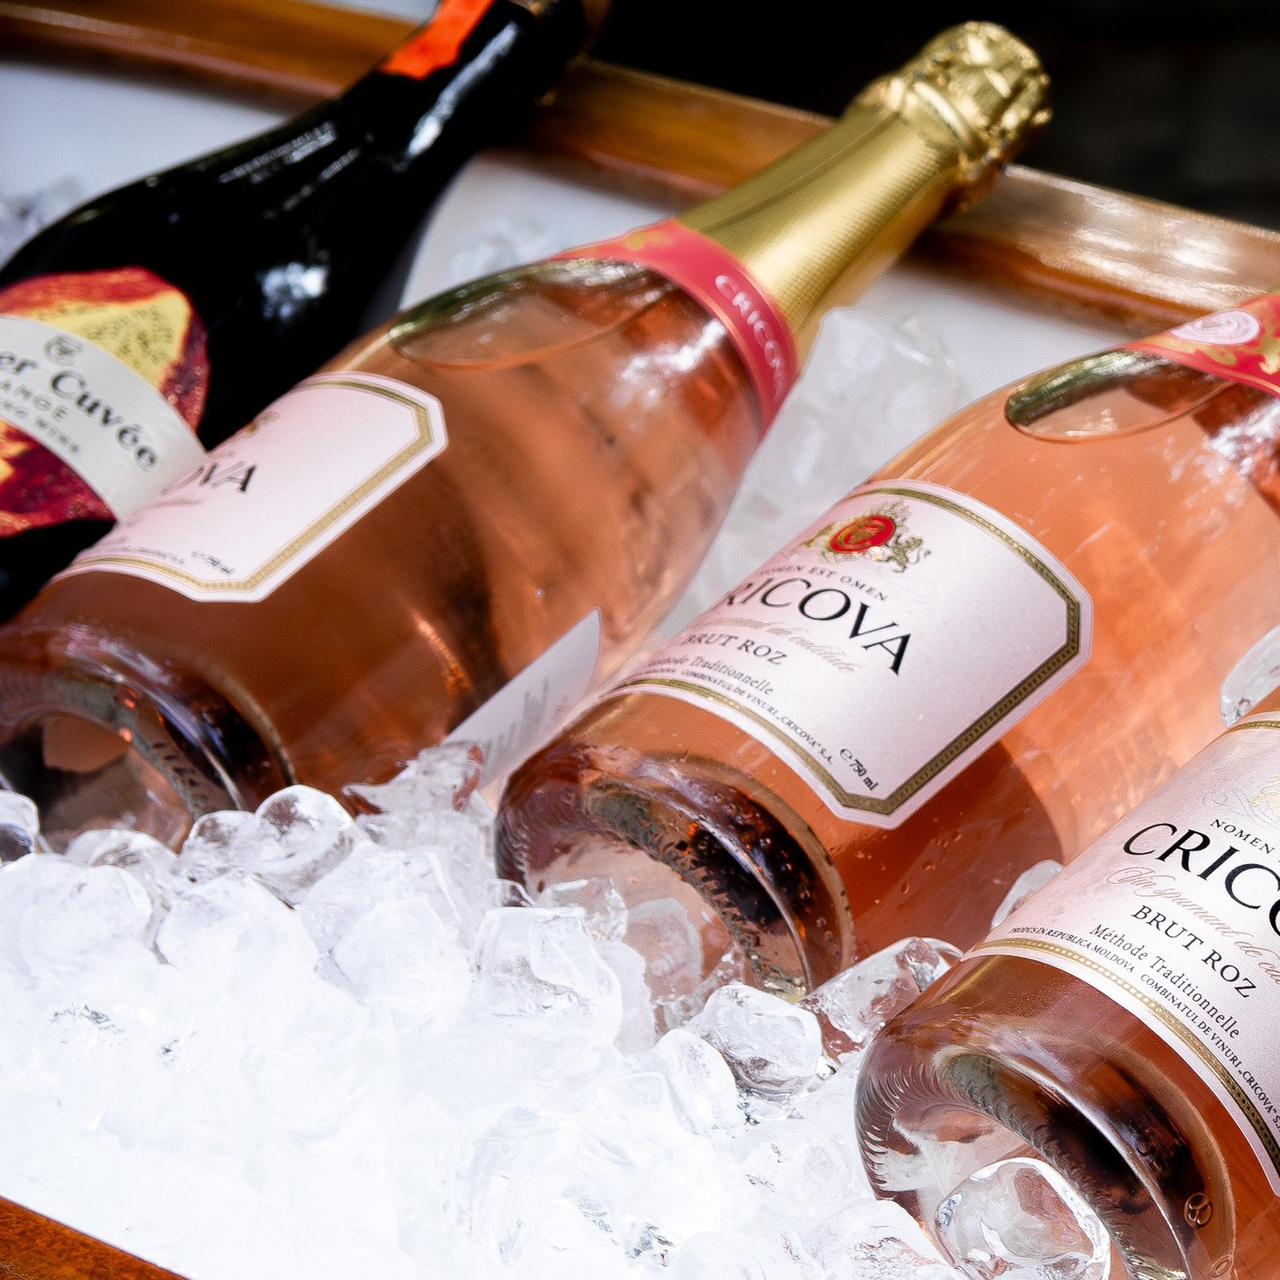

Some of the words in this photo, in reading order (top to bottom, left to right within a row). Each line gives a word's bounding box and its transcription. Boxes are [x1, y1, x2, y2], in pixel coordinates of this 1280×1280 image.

[50, 369, 157, 471] Cuvée
[840, 575, 888, 602] OMEN
[738, 639, 787, 667] ROZ
[690, 656, 774, 697] Traditionnelle
[747, 693, 779, 717] VINURI
[848, 759, 868, 779] 750
[862, 775, 880, 792] ml
[1210, 818, 1275, 855] NOMEN
[1131, 904, 1205, 952] BRUT
[1201, 948, 1258, 999] ROZ
[1045, 927, 1092, 950] REPUBLICA
[1091, 944, 1136, 974] MOLDOVA
[1140, 973, 1198, 1025] COMBINATUL
[1196, 1020, 1212, 1037] DE
[1210, 1032, 1241, 1068] VINURI
[1089, 923, 1149, 962] Méthode
[1149, 954, 1240, 1039] Traditionnelle
